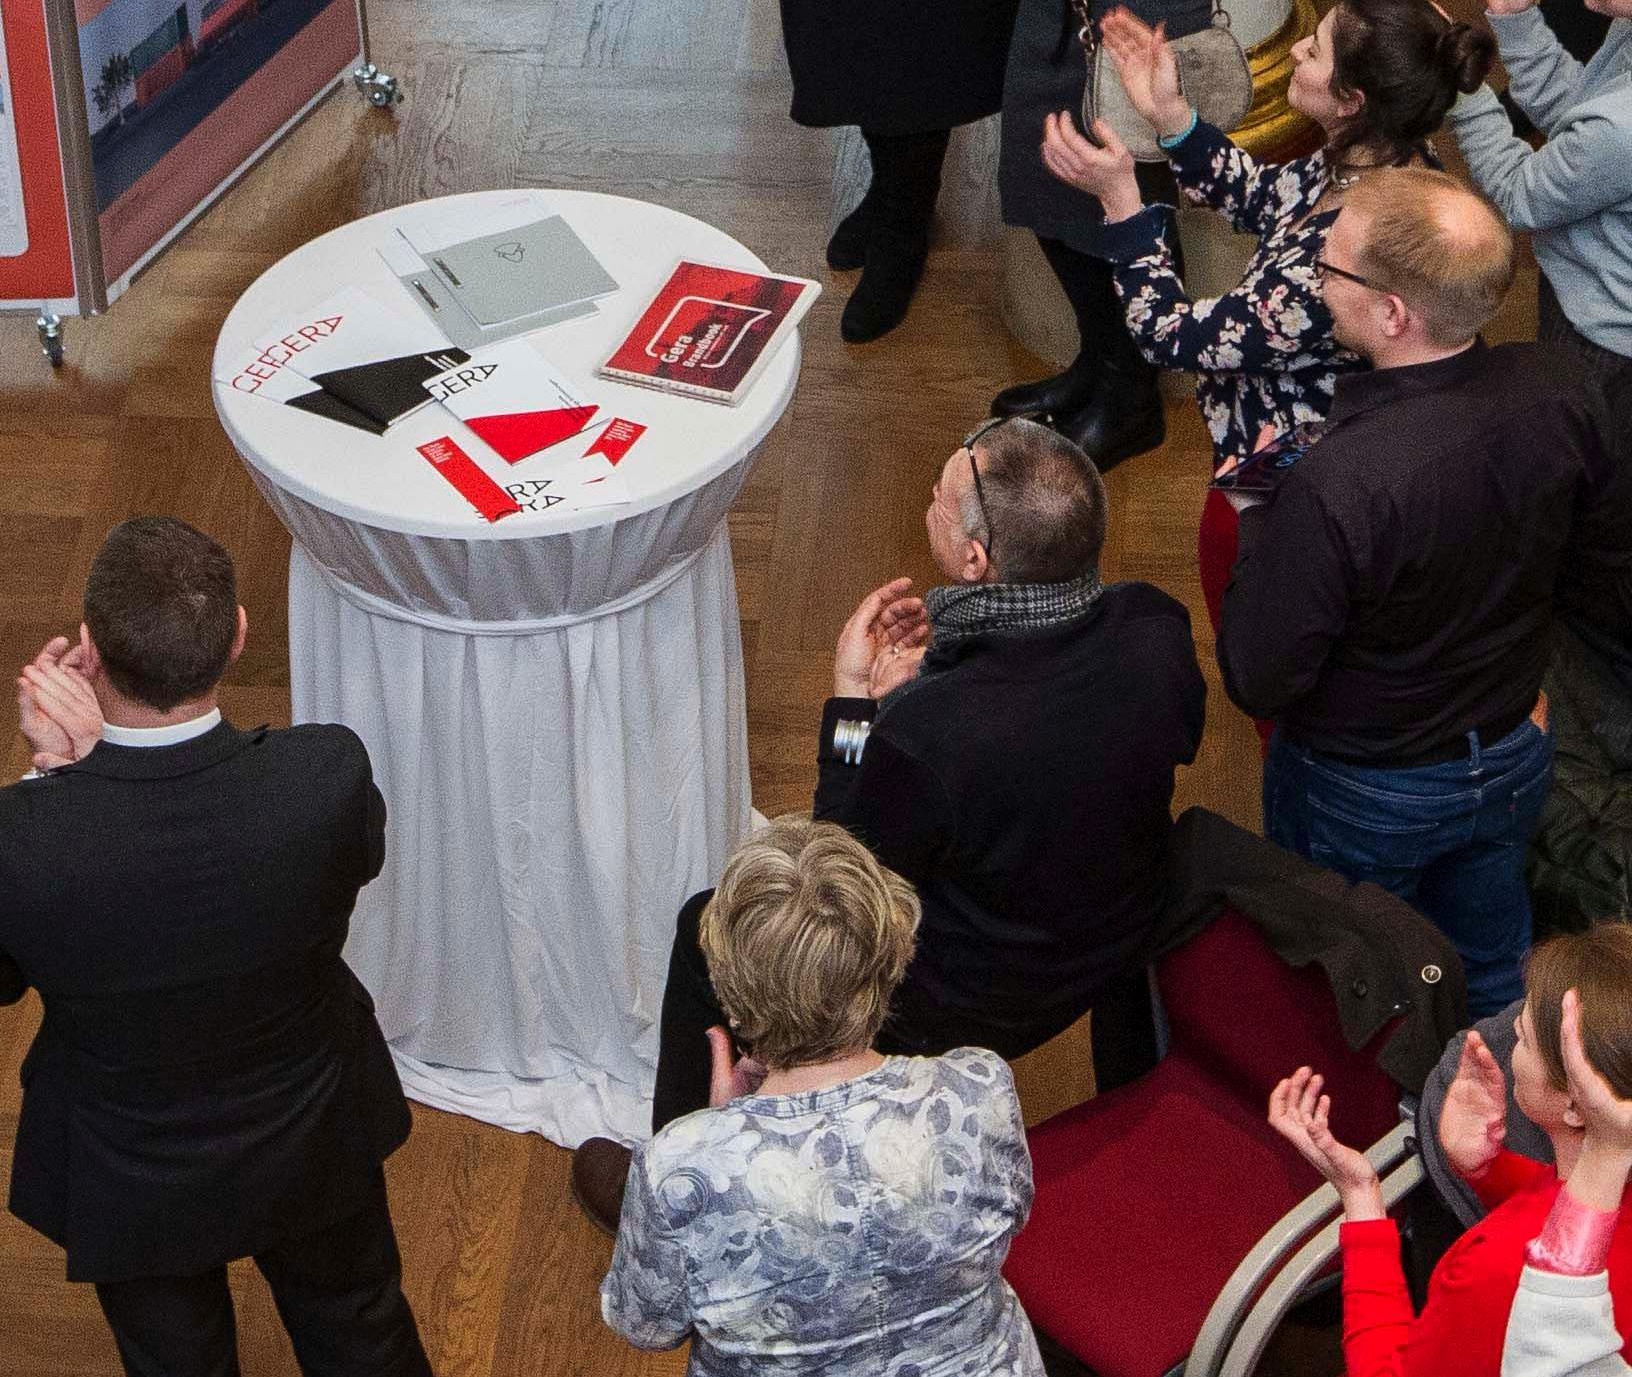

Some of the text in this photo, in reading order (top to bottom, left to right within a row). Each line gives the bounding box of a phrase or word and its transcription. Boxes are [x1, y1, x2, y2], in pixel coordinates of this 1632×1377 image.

[264, 315, 345, 366] GERA
[659, 332, 693, 365] Gera
[681, 322, 724, 369] Brandbook
[426, 363, 499, 403] GERA
[504, 478, 554, 502] RA
